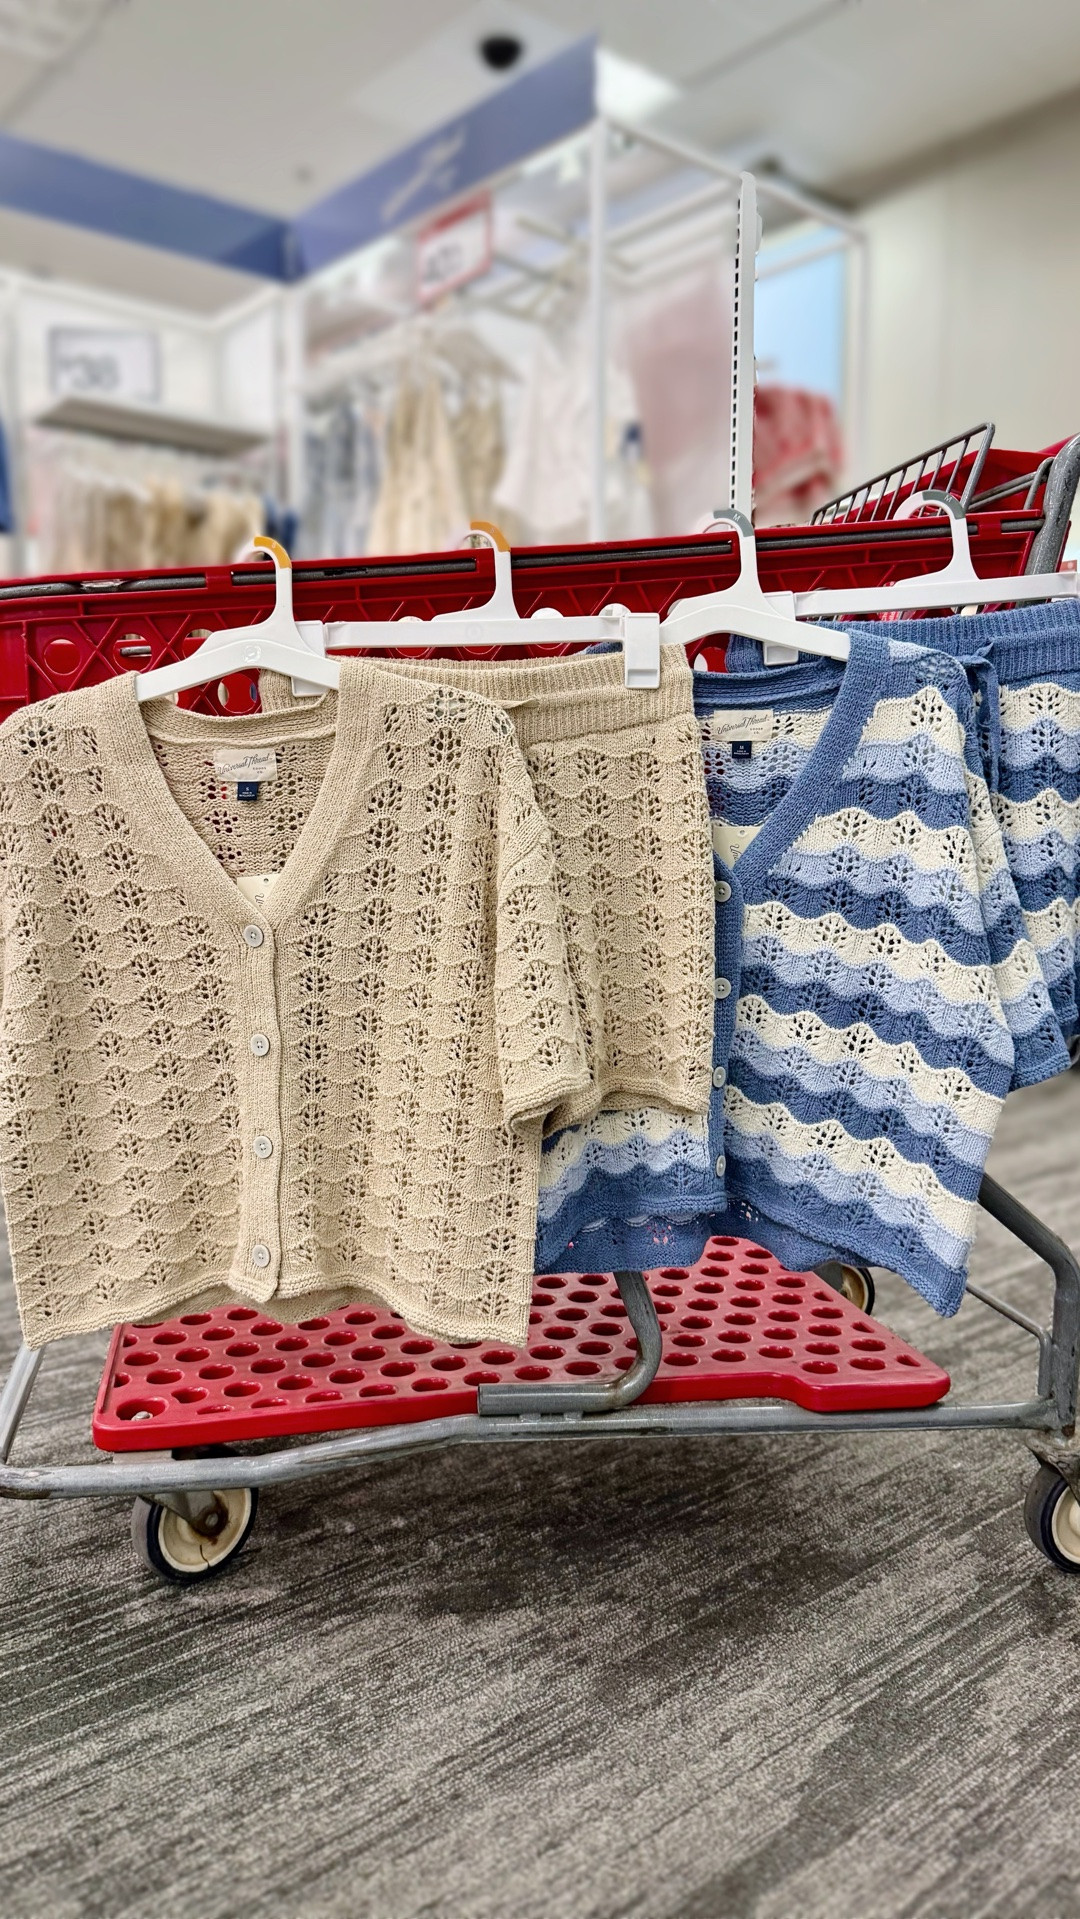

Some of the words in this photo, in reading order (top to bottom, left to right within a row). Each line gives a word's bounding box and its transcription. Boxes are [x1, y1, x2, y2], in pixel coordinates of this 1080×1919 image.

[943, 494, 953, 503] M
[732, 513, 741, 522] M
[716, 718, 747, 734] Universal
[742, 714, 768, 728] Thread
[217, 758, 248, 775] Universal
[243, 753, 270, 769] Thread
